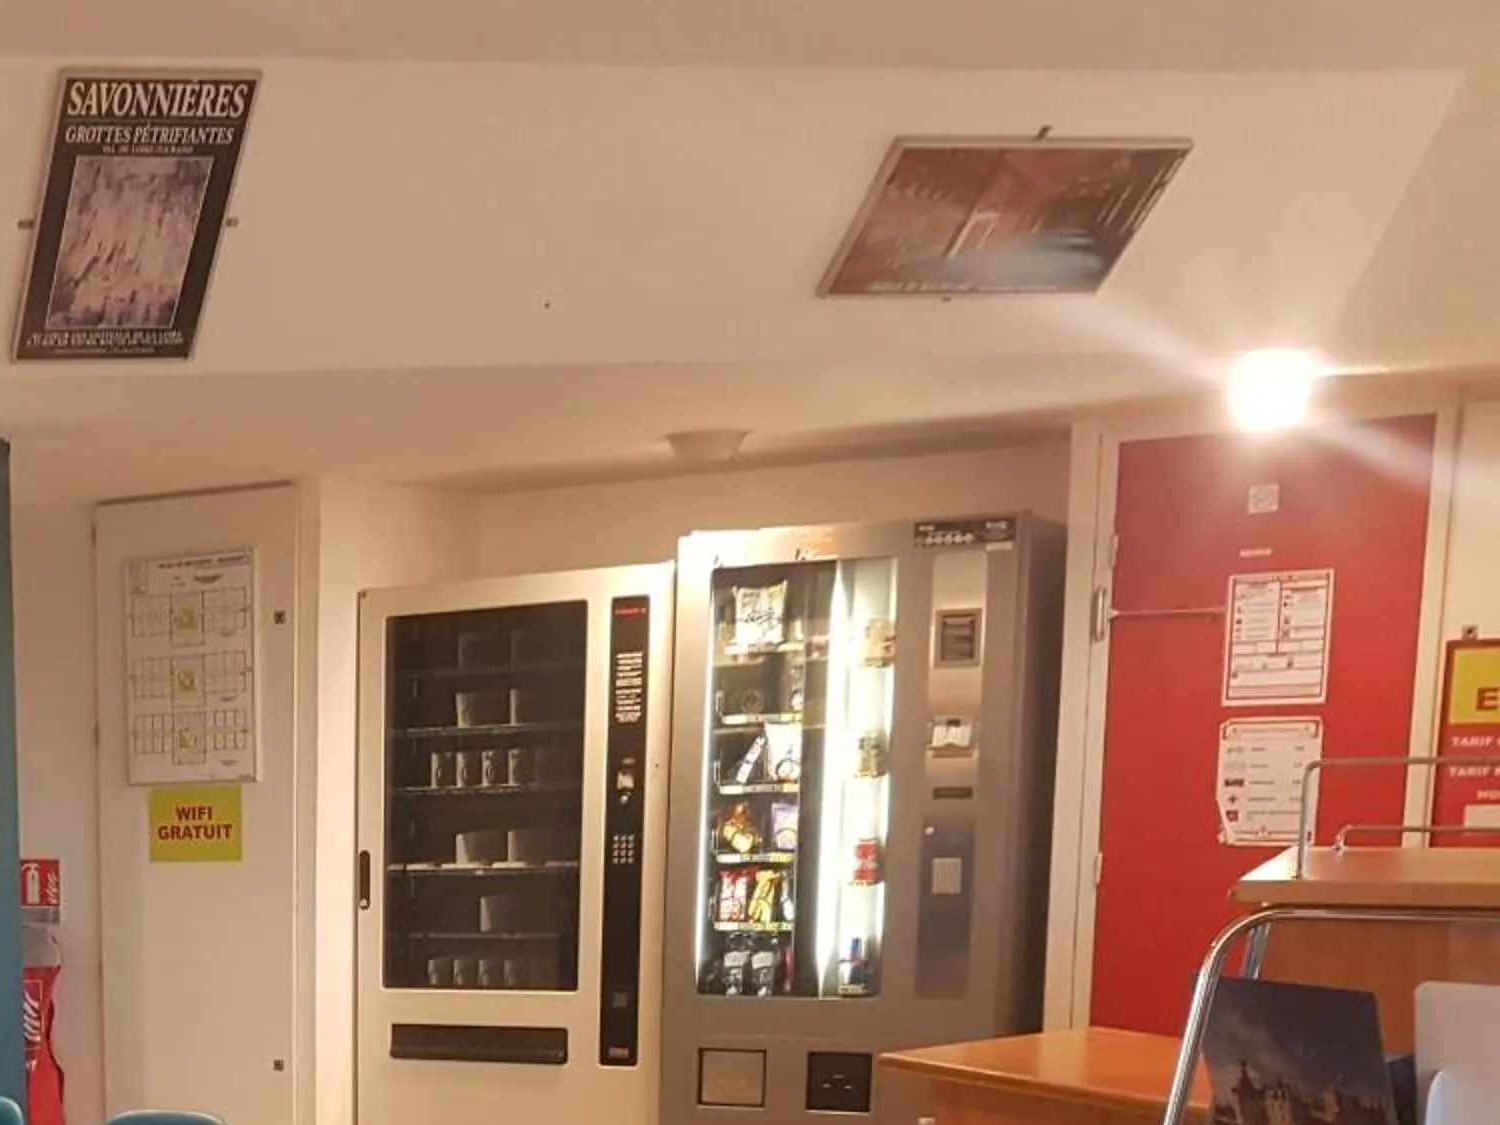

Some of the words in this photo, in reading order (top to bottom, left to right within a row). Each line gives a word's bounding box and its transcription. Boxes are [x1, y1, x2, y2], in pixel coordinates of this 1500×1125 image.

[65, 124, 132, 144] GROTTES
[1451, 735, 1494, 748] TARIF
[1449, 765, 1491, 778] TARIF
[175, 805, 213, 821] WIFI
[157, 824, 233, 841] GRATUIT
